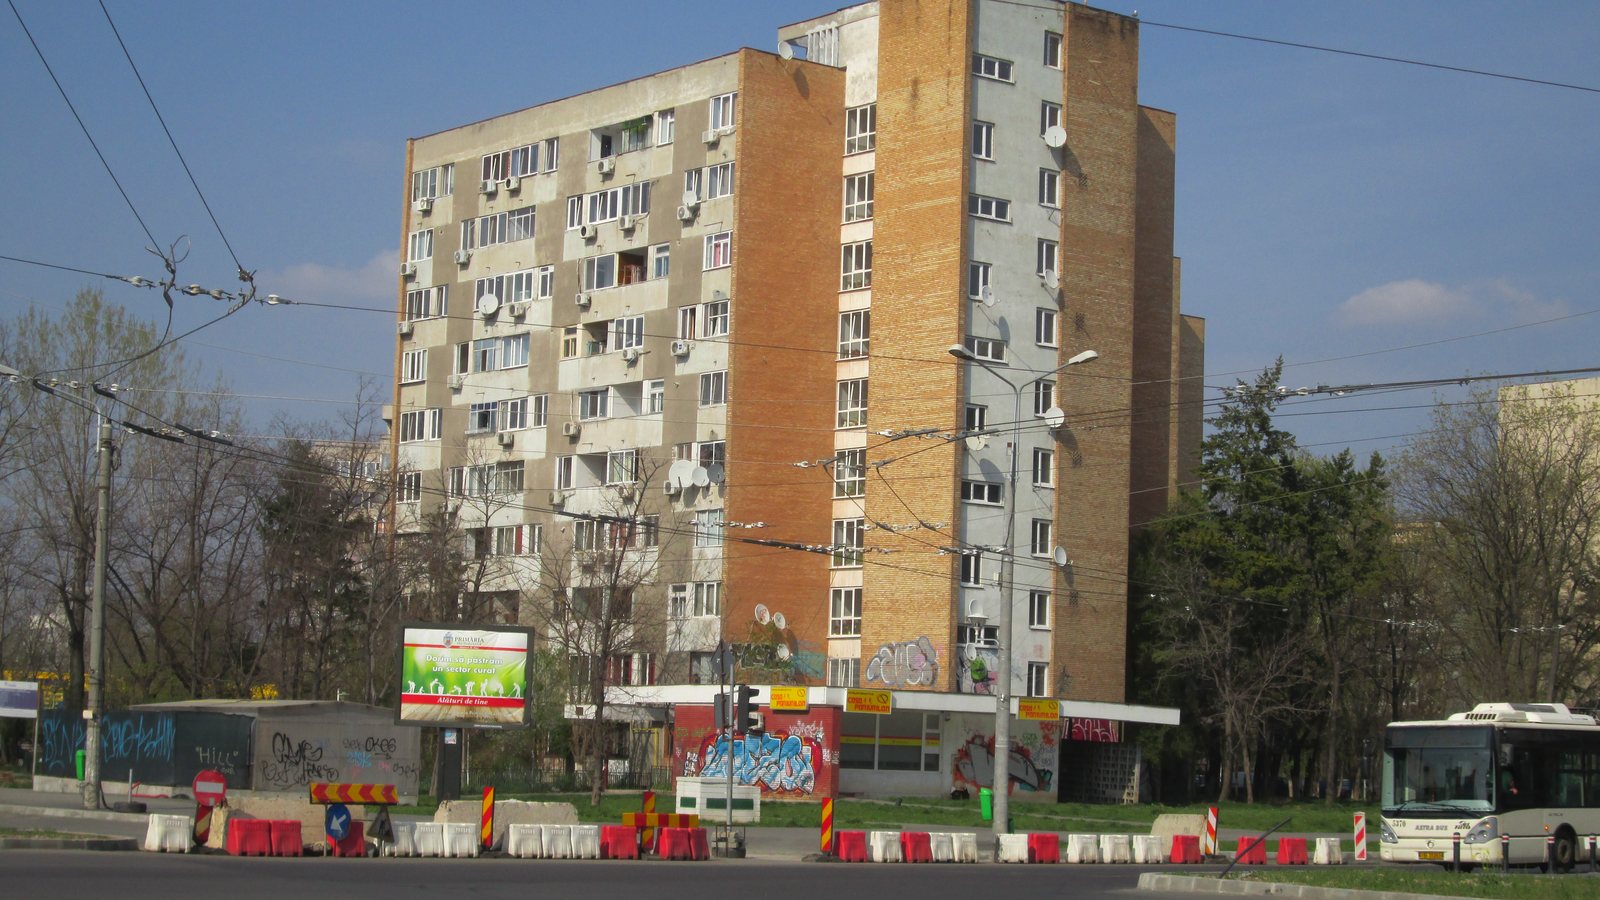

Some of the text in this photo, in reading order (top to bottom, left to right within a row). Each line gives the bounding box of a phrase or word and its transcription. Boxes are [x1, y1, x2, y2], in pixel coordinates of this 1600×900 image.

[426, 654, 452, 662] Dorim
[446, 665, 471, 673] sector
[437, 696, 463, 704] Alături
[474, 698, 488, 706] tine
